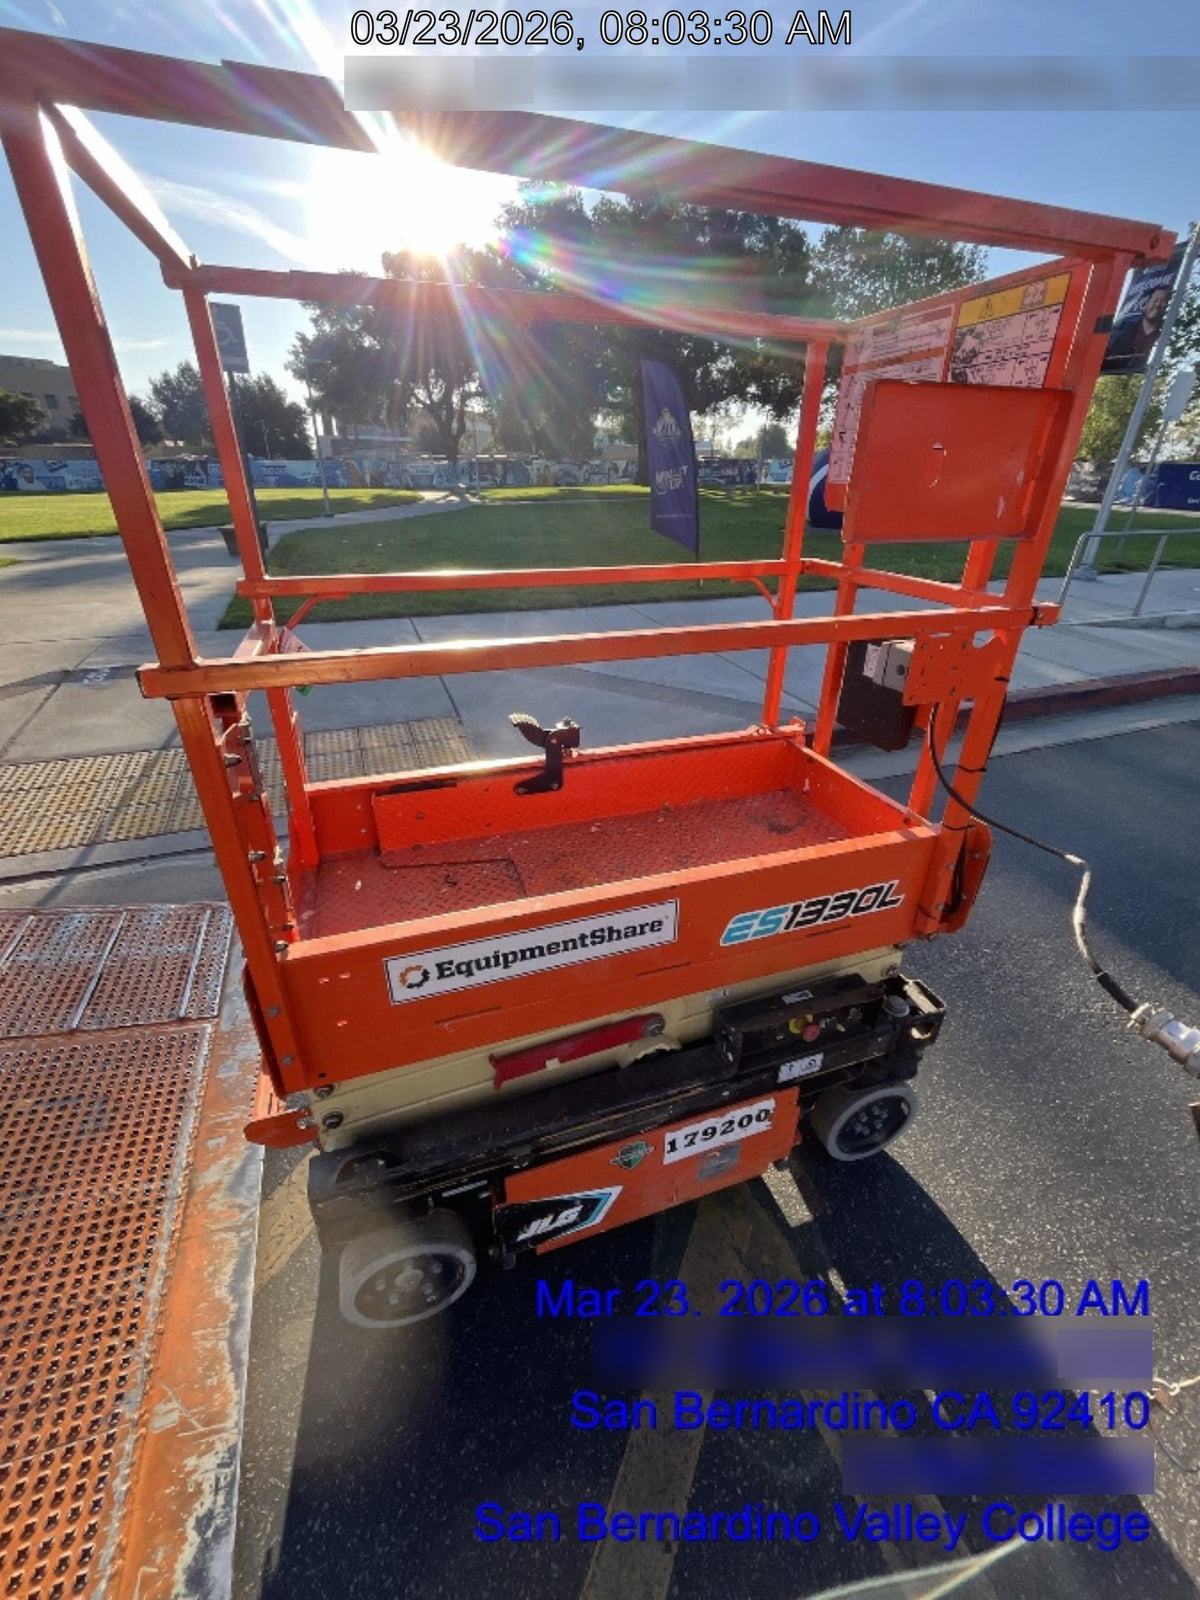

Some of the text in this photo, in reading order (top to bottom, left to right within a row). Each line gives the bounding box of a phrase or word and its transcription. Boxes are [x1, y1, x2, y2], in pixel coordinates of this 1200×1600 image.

[720, 880, 904, 946] ES1330L
[435, 917, 665, 980] EquipmentShare
[666, 1108, 772, 1154] 179200
[516, 1204, 584, 1242] JLG
